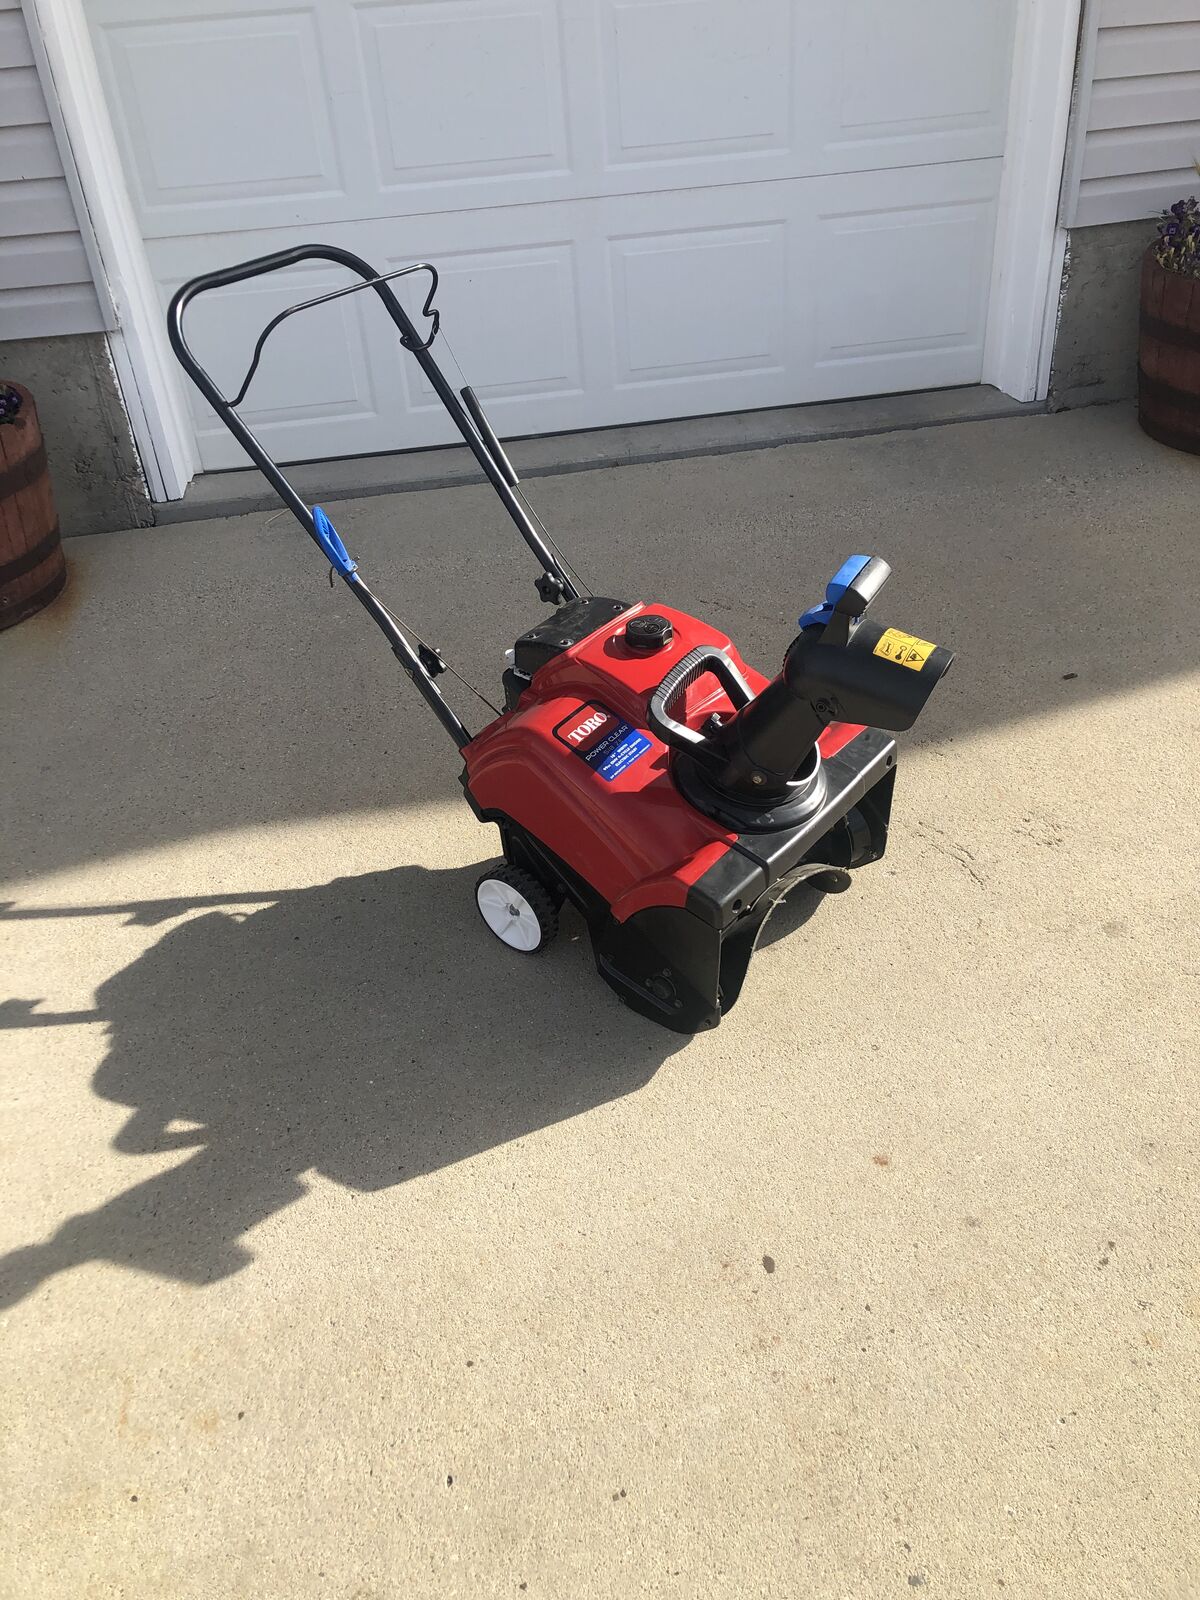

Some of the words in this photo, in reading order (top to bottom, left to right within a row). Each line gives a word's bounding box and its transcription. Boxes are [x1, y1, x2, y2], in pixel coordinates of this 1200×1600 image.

[567, 712, 608, 742] TORO
[585, 740, 609, 761] POWER
[608, 725, 629, 742] CLEAR
